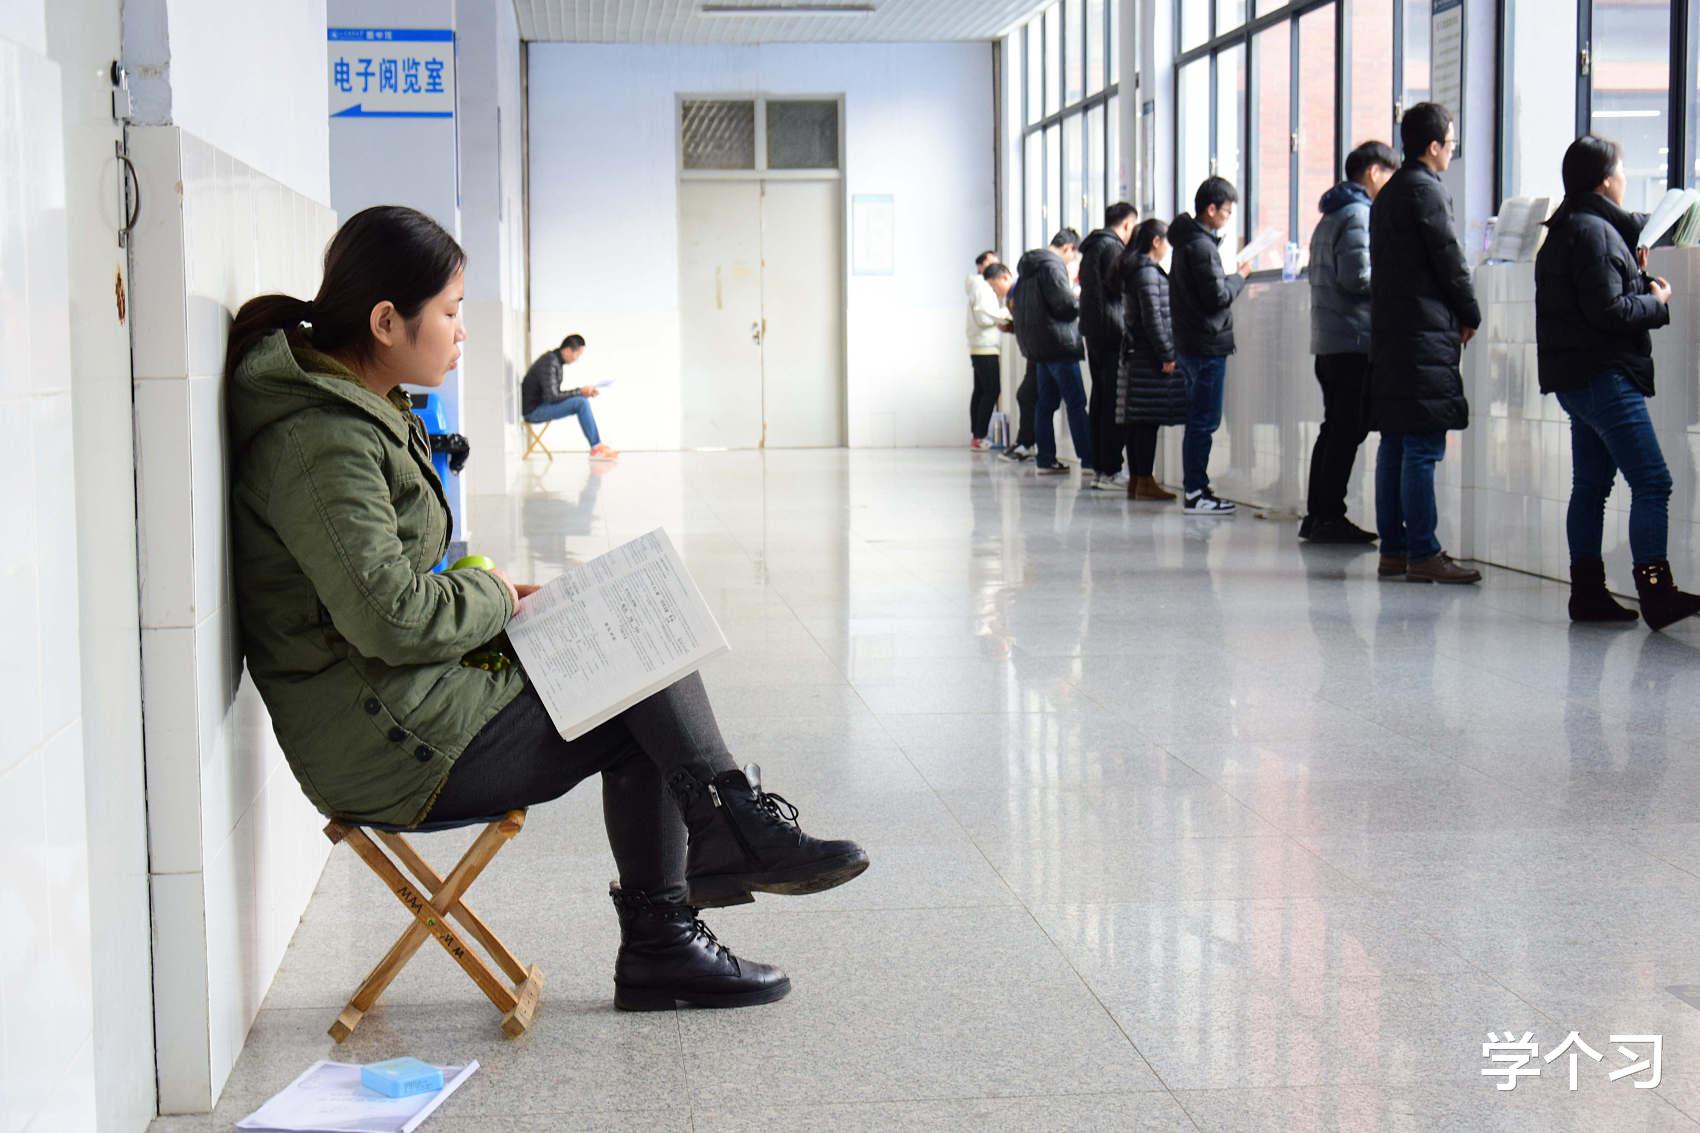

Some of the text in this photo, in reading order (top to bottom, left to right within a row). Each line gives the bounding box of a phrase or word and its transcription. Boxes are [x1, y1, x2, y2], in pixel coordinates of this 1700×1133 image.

[333, 56, 445, 94] 电子阅览室
